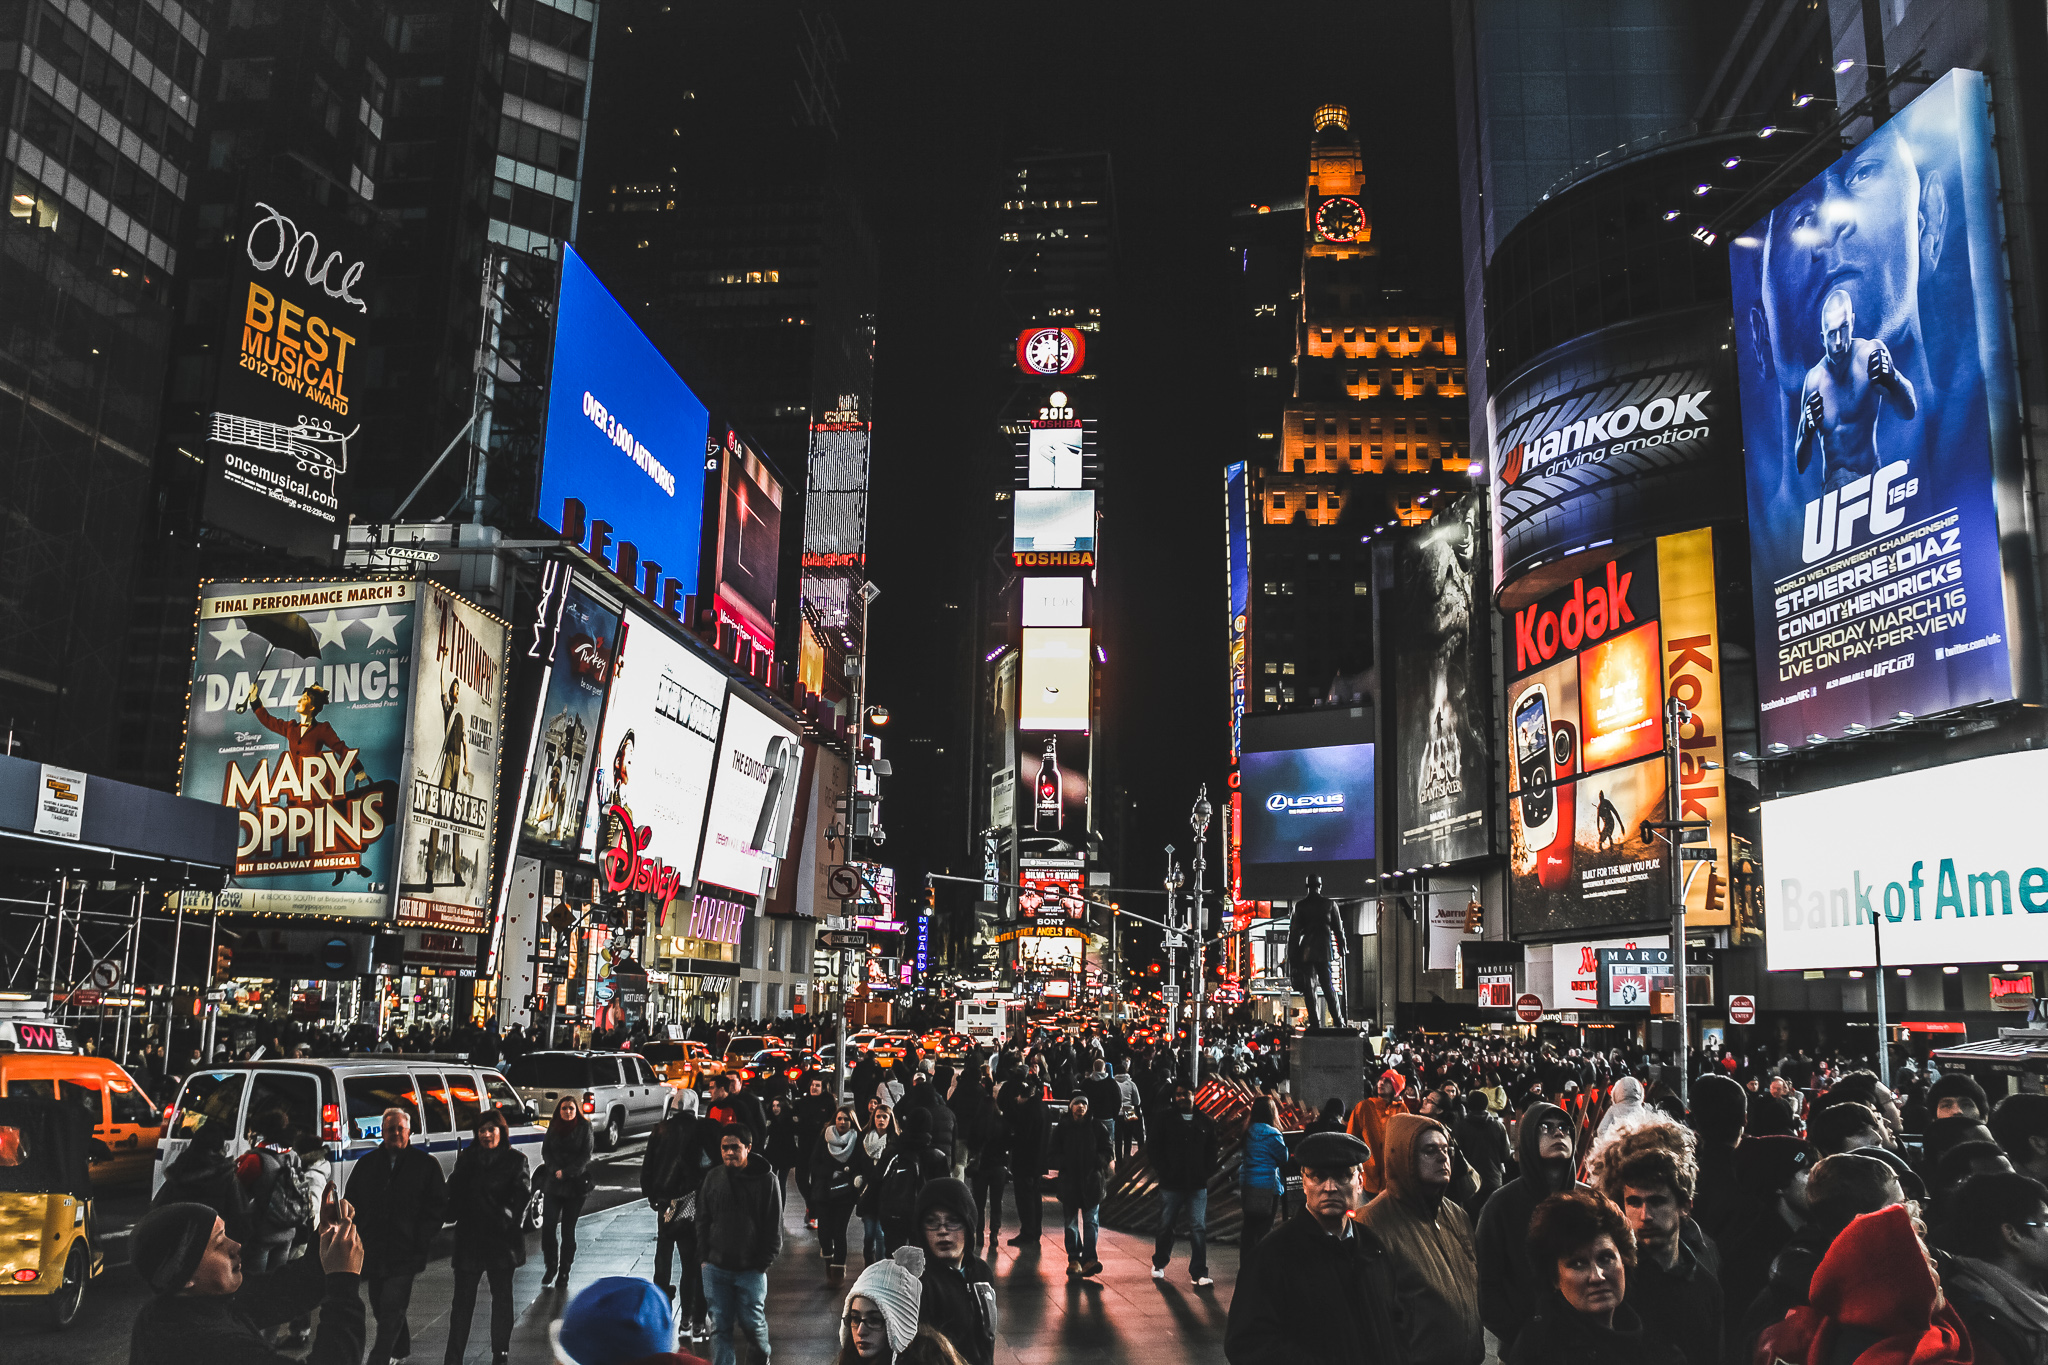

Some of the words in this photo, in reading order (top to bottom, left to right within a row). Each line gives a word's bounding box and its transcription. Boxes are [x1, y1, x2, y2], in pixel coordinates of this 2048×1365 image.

[245, 281, 356, 374] BEST
[241, 325, 349, 402] MUSICAL
[239, 352, 269, 378] 2012
[270, 369, 305, 394] TONY
[305, 385, 349, 416] AWARD
[1031, 419, 1082, 429] TOSHIBA
[1039, 407, 1073, 420] 2013
[582, 390, 607, 433] OVER
[607, 415, 633, 457] 3,000
[633, 440, 675, 498] ARTWORKS
[1545, 446, 1606, 478] driving
[1610, 425, 1710, 457] emotion
[225, 453, 338, 510] oncemusical.com
[302, 503, 335, 522] 212-239-6200
[1802, 459, 1909, 563] UFC
[1888, 478, 1919, 506] 158
[391, 548, 436, 561] LAMAR
[1013, 552, 1094, 566] TOSHIBA
[1774, 576, 1806, 596] WORLD
[1807, 546, 1878, 581] WELTERWEIGHT
[1879, 514, 1959, 553] CHAMPIONSHIP
[1775, 558, 1890, 618] ST-PIERRE
[1897, 528, 1961, 572] DIAZ
[214, 599, 249, 614] FINAL
[252, 590, 343, 611] PERFORMANCE
[347, 585, 393, 602] MARCH
[397, 584, 406, 597] 3
[1778, 604, 1841, 642] CONDIT
[1847, 559, 1962, 617] HENDRICKS
[1515, 560, 1635, 672] Kodak
[1778, 621, 1867, 666] SATURDAY
[1869, 597, 1942, 635] MARCH
[1943, 588, 1967, 607] 16
[1779, 660, 1813, 682] LIVE
[1816, 649, 1841, 670] ON
[1843, 607, 1967, 664] PAY-PER-VIEW
[1945, 632, 2001, 657] twitter.com/ufc
[574, 643, 606, 681] Turkey
[1826, 678, 1839, 690] ALSO
[1839, 671, 1865, 686] AVAILABLE
[352, 701, 382, 710] Associated
[383, 700, 399, 708] Press
[1760, 688, 1810, 712] facebook.com/UFC
[234, 731, 262, 743] Disney
[1667, 634, 1719, 821] Kodak
[732, 749, 744, 773] THE
[226, 748, 359, 807] MARY
[1287, 793, 1344, 807] LEXUS
[1419, 790, 1439, 804] GIANT
[1438, 779, 1462, 798] SLAYER
[413, 780, 488, 828] NEWSIES
[1429, 808, 1447, 822] MARCH
[236, 792, 384, 857] OPPINS
[238, 863, 254, 872] HIT
[256, 859, 311, 871] BROADWAY
[313, 856, 357, 868] MUSICAL
[1025, 871, 1046, 880] SILVA
[1582, 868, 1597, 880] BUILT
[1597, 867, 1608, 878] FOR
[1608, 865, 1619, 876] THE
[1619, 862, 1632, 874] WAY
[1632, 860, 1645, 872] YOU
[1645, 858, 1661, 870] PLAY.
[266, 893, 292, 901] BLOCKS
[294, 894, 315, 902] SOUTH
[325, 895, 356, 905] Broadway
[1781, 869, 1875, 932] Bank
[1883, 860, 1925, 923] of
[688, 894, 746, 945] FOREVER
[859, 905, 865, 914] W
[866, 905, 875, 914] 46
[1435, 908, 1466, 919] Marrio
[1036, 926, 1063, 937] ANGELS
[1037, 918, 1066, 926] SONY
[830, 935, 845, 943] ONE
[847, 935, 864, 944] WAY
[918, 916, 928, 970] NYGARD
[1608, 951, 1714, 961] MARQIS
[460, 968, 477, 977] SONY
[1477, 965, 1513, 974] MARQUIS
